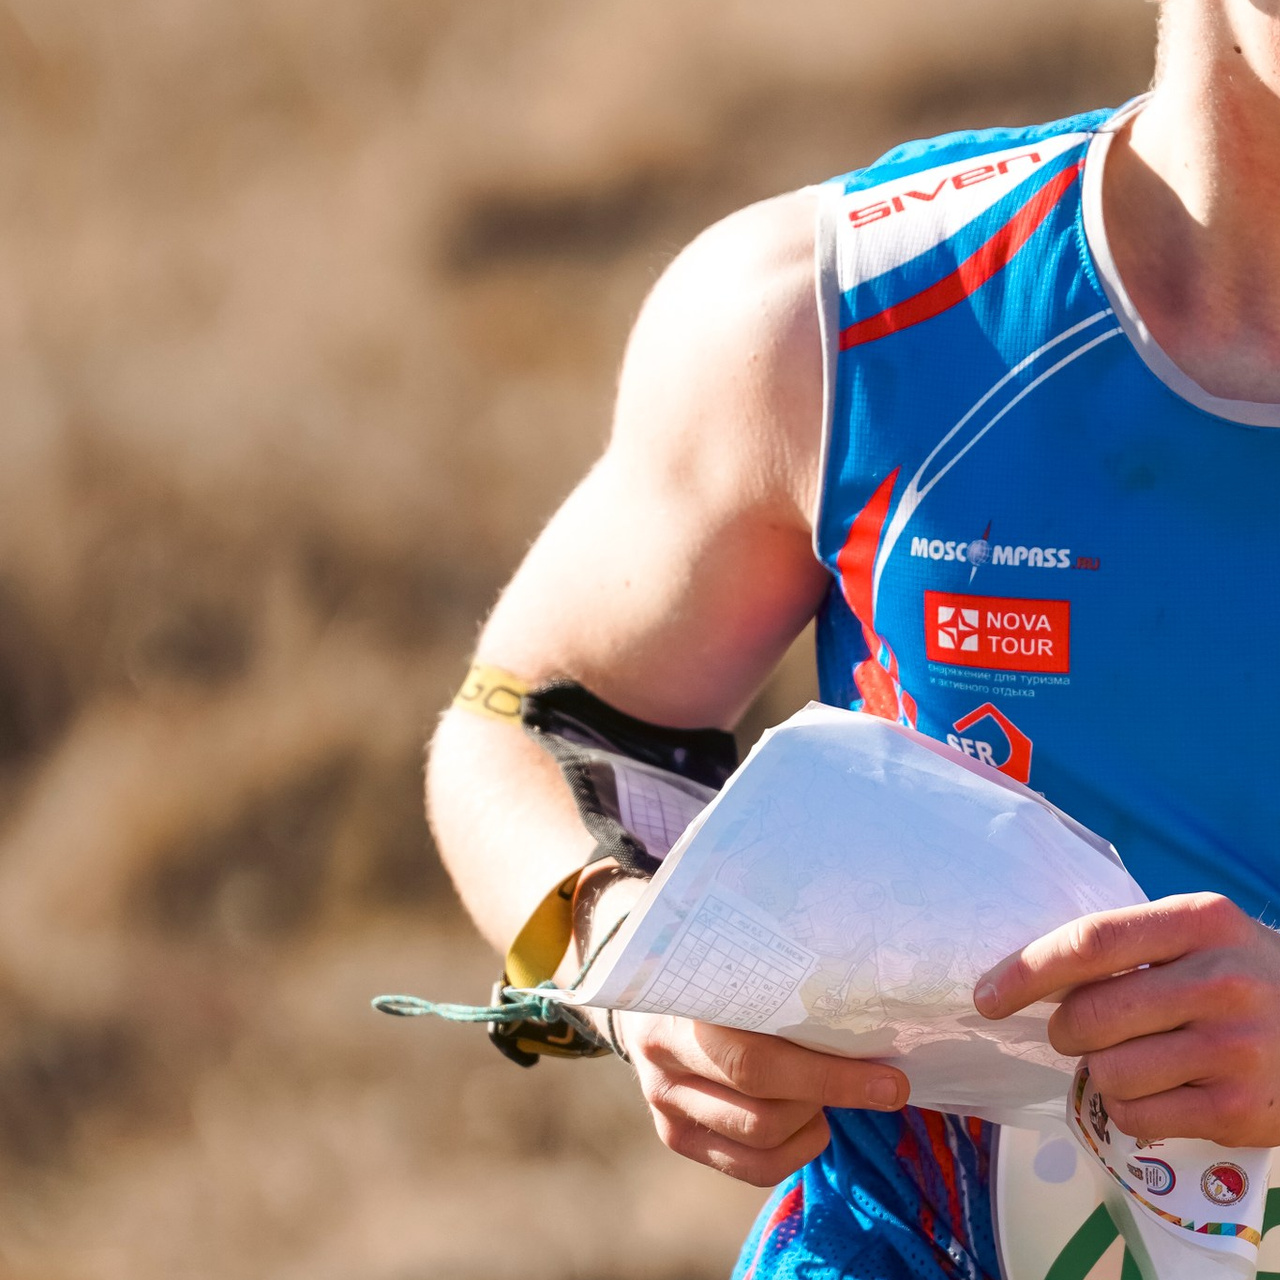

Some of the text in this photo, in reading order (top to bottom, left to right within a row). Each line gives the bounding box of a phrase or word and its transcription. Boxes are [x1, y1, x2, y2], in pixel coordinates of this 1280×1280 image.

[986, 611, 1052, 632] NOVA
[986, 635, 1054, 656] TOUR
[938, 679, 990, 694] активного
[992, 687, 1036, 698] отдыха
[994, 672, 1017, 683] для
[1021, 674, 1071, 687] туризма
